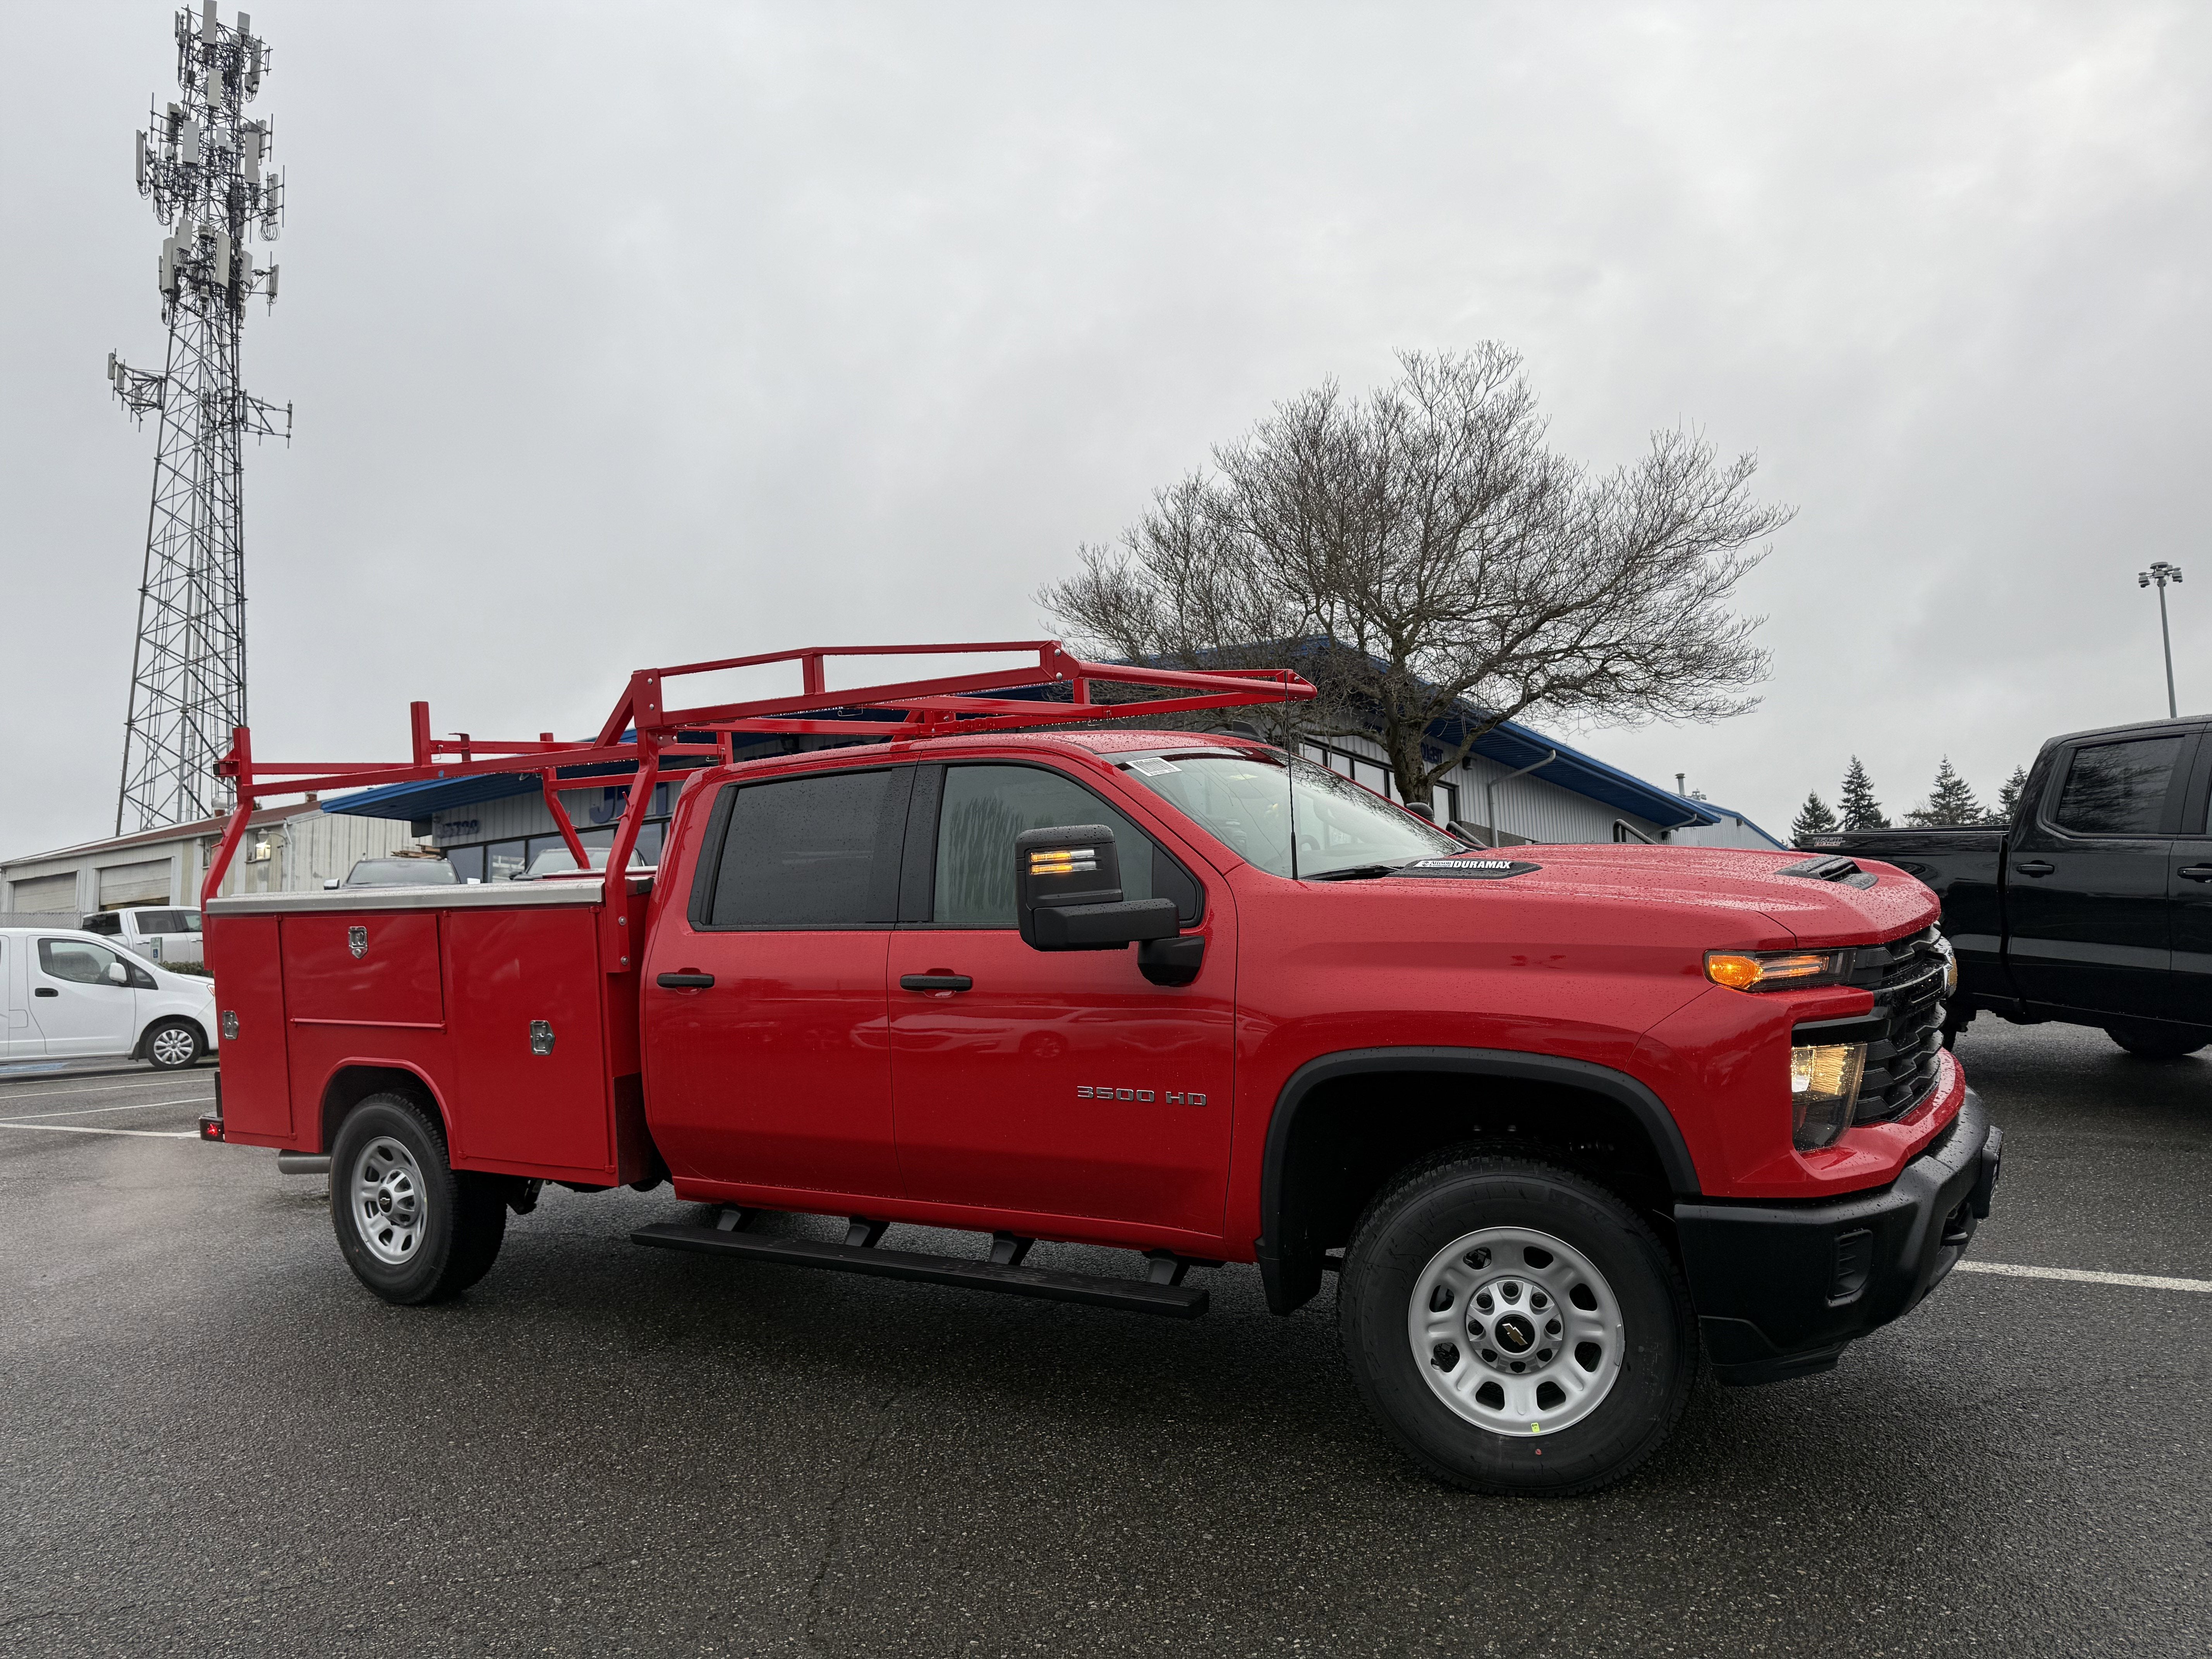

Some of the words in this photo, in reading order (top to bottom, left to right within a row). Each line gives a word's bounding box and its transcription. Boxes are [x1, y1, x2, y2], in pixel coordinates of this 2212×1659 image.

[1453, 860, 1511, 869] DURAMAX
[1077, 1086, 1154, 1102] 3500
[1166, 1091, 1206, 1106] HD
